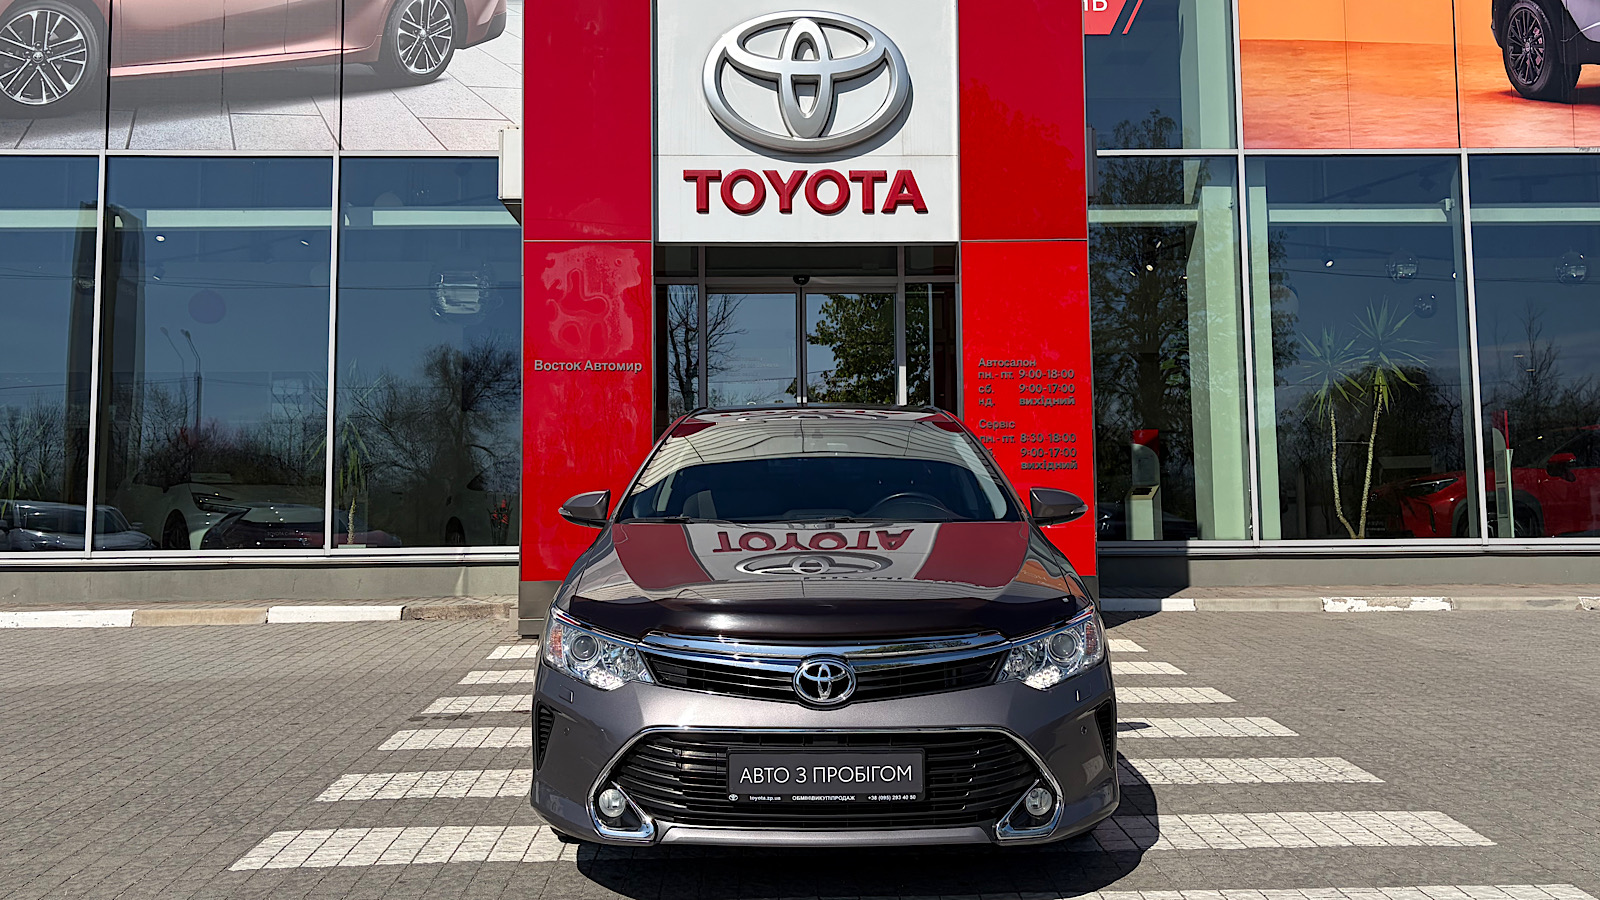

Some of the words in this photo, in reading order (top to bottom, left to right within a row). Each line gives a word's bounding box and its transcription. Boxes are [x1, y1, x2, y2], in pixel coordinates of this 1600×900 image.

[683, 169, 928, 215] TOYOTA
[534, 360, 581, 371] Восток
[584, 360, 643, 374] Автомир
[978, 358, 1036, 367] Автосалон
[1019, 369, 1075, 379] 9:00-18:00
[978, 384, 995, 394] сб.
[1019, 384, 1075, 394] 9:00-17:00
[978, 398, 995, 407] нд.
[1019, 396, 1075, 407] вихідний
[979, 419, 1016, 431] Сервіс
[1020, 433, 1077, 443] 8:30-18:00
[1020, 448, 1077, 458] 9:00-17:00
[1021, 460, 1078, 471] вихідний
[739, 767, 790, 784] АВТО
[813, 765, 912, 783] ПРОБІГОМ
